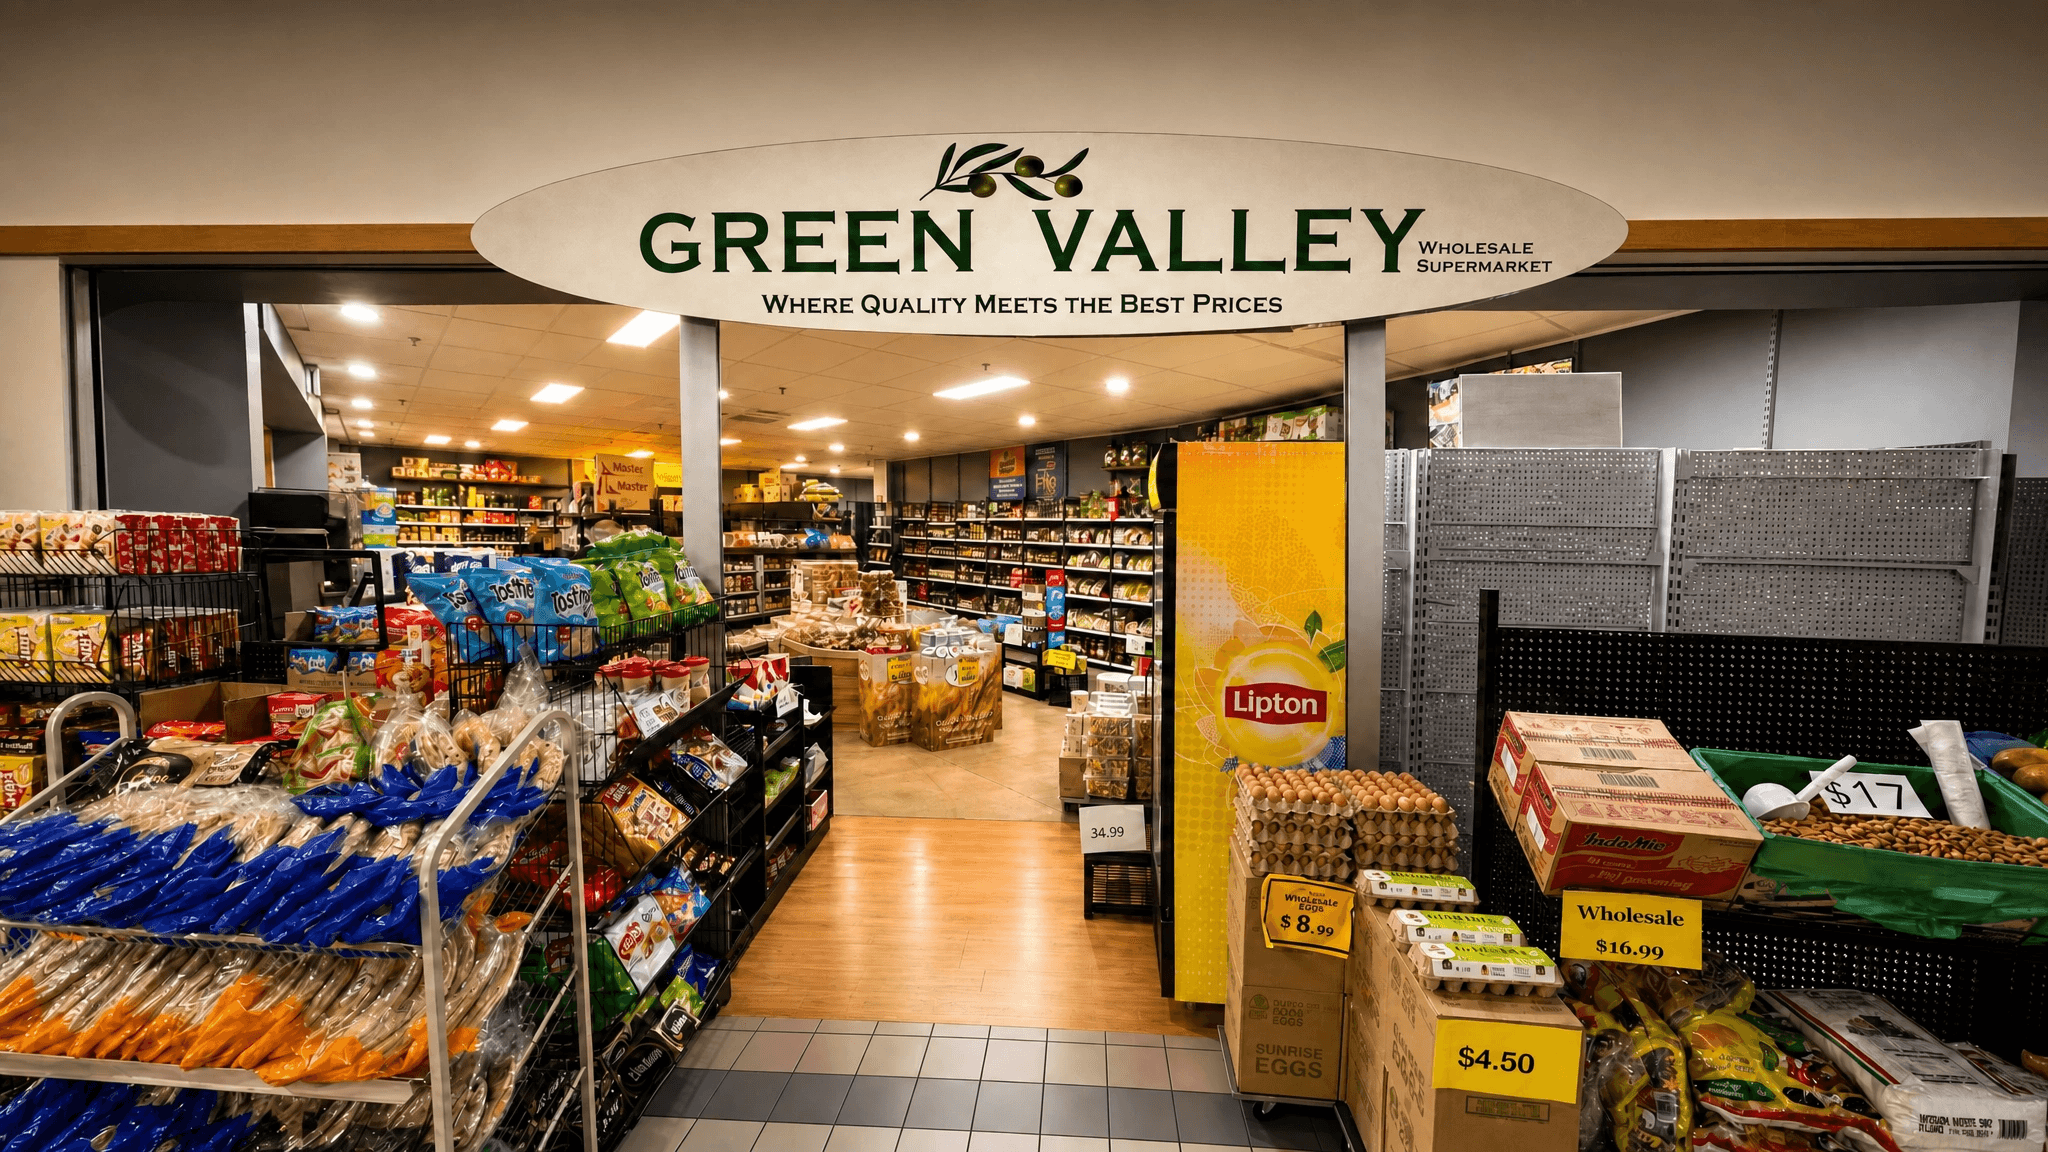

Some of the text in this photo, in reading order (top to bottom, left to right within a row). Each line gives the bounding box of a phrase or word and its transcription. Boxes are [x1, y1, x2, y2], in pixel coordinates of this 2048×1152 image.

[639, 206, 1426, 275] GREEN VALLEY
[1418, 240, 1534, 255] WHOLESALE
[1416, 258, 1553, 273] SUPERMARKET
[762, 294, 854, 314] WHERE
[860, 294, 967, 316] QUALITY
[975, 294, 1058, 314] MEETS
[1120, 294, 1185, 314] BEST
[1192, 294, 1284, 314] PRICES
[613, 462, 643, 474] Master
[617, 480, 648, 492] Master
[1233, 689, 1318, 719] Lipton
[1824, 779, 1905, 810] $17
[1090, 826, 1125, 839] 34.99
[1576, 904, 1685, 927] Wholesale
[1595, 939, 1665, 961] $16.99
[1255, 1043, 1324, 1061] SUNRISE
[1457, 1045, 1536, 1075] $4.50
[1255, 1056, 1323, 1079] EGGS
